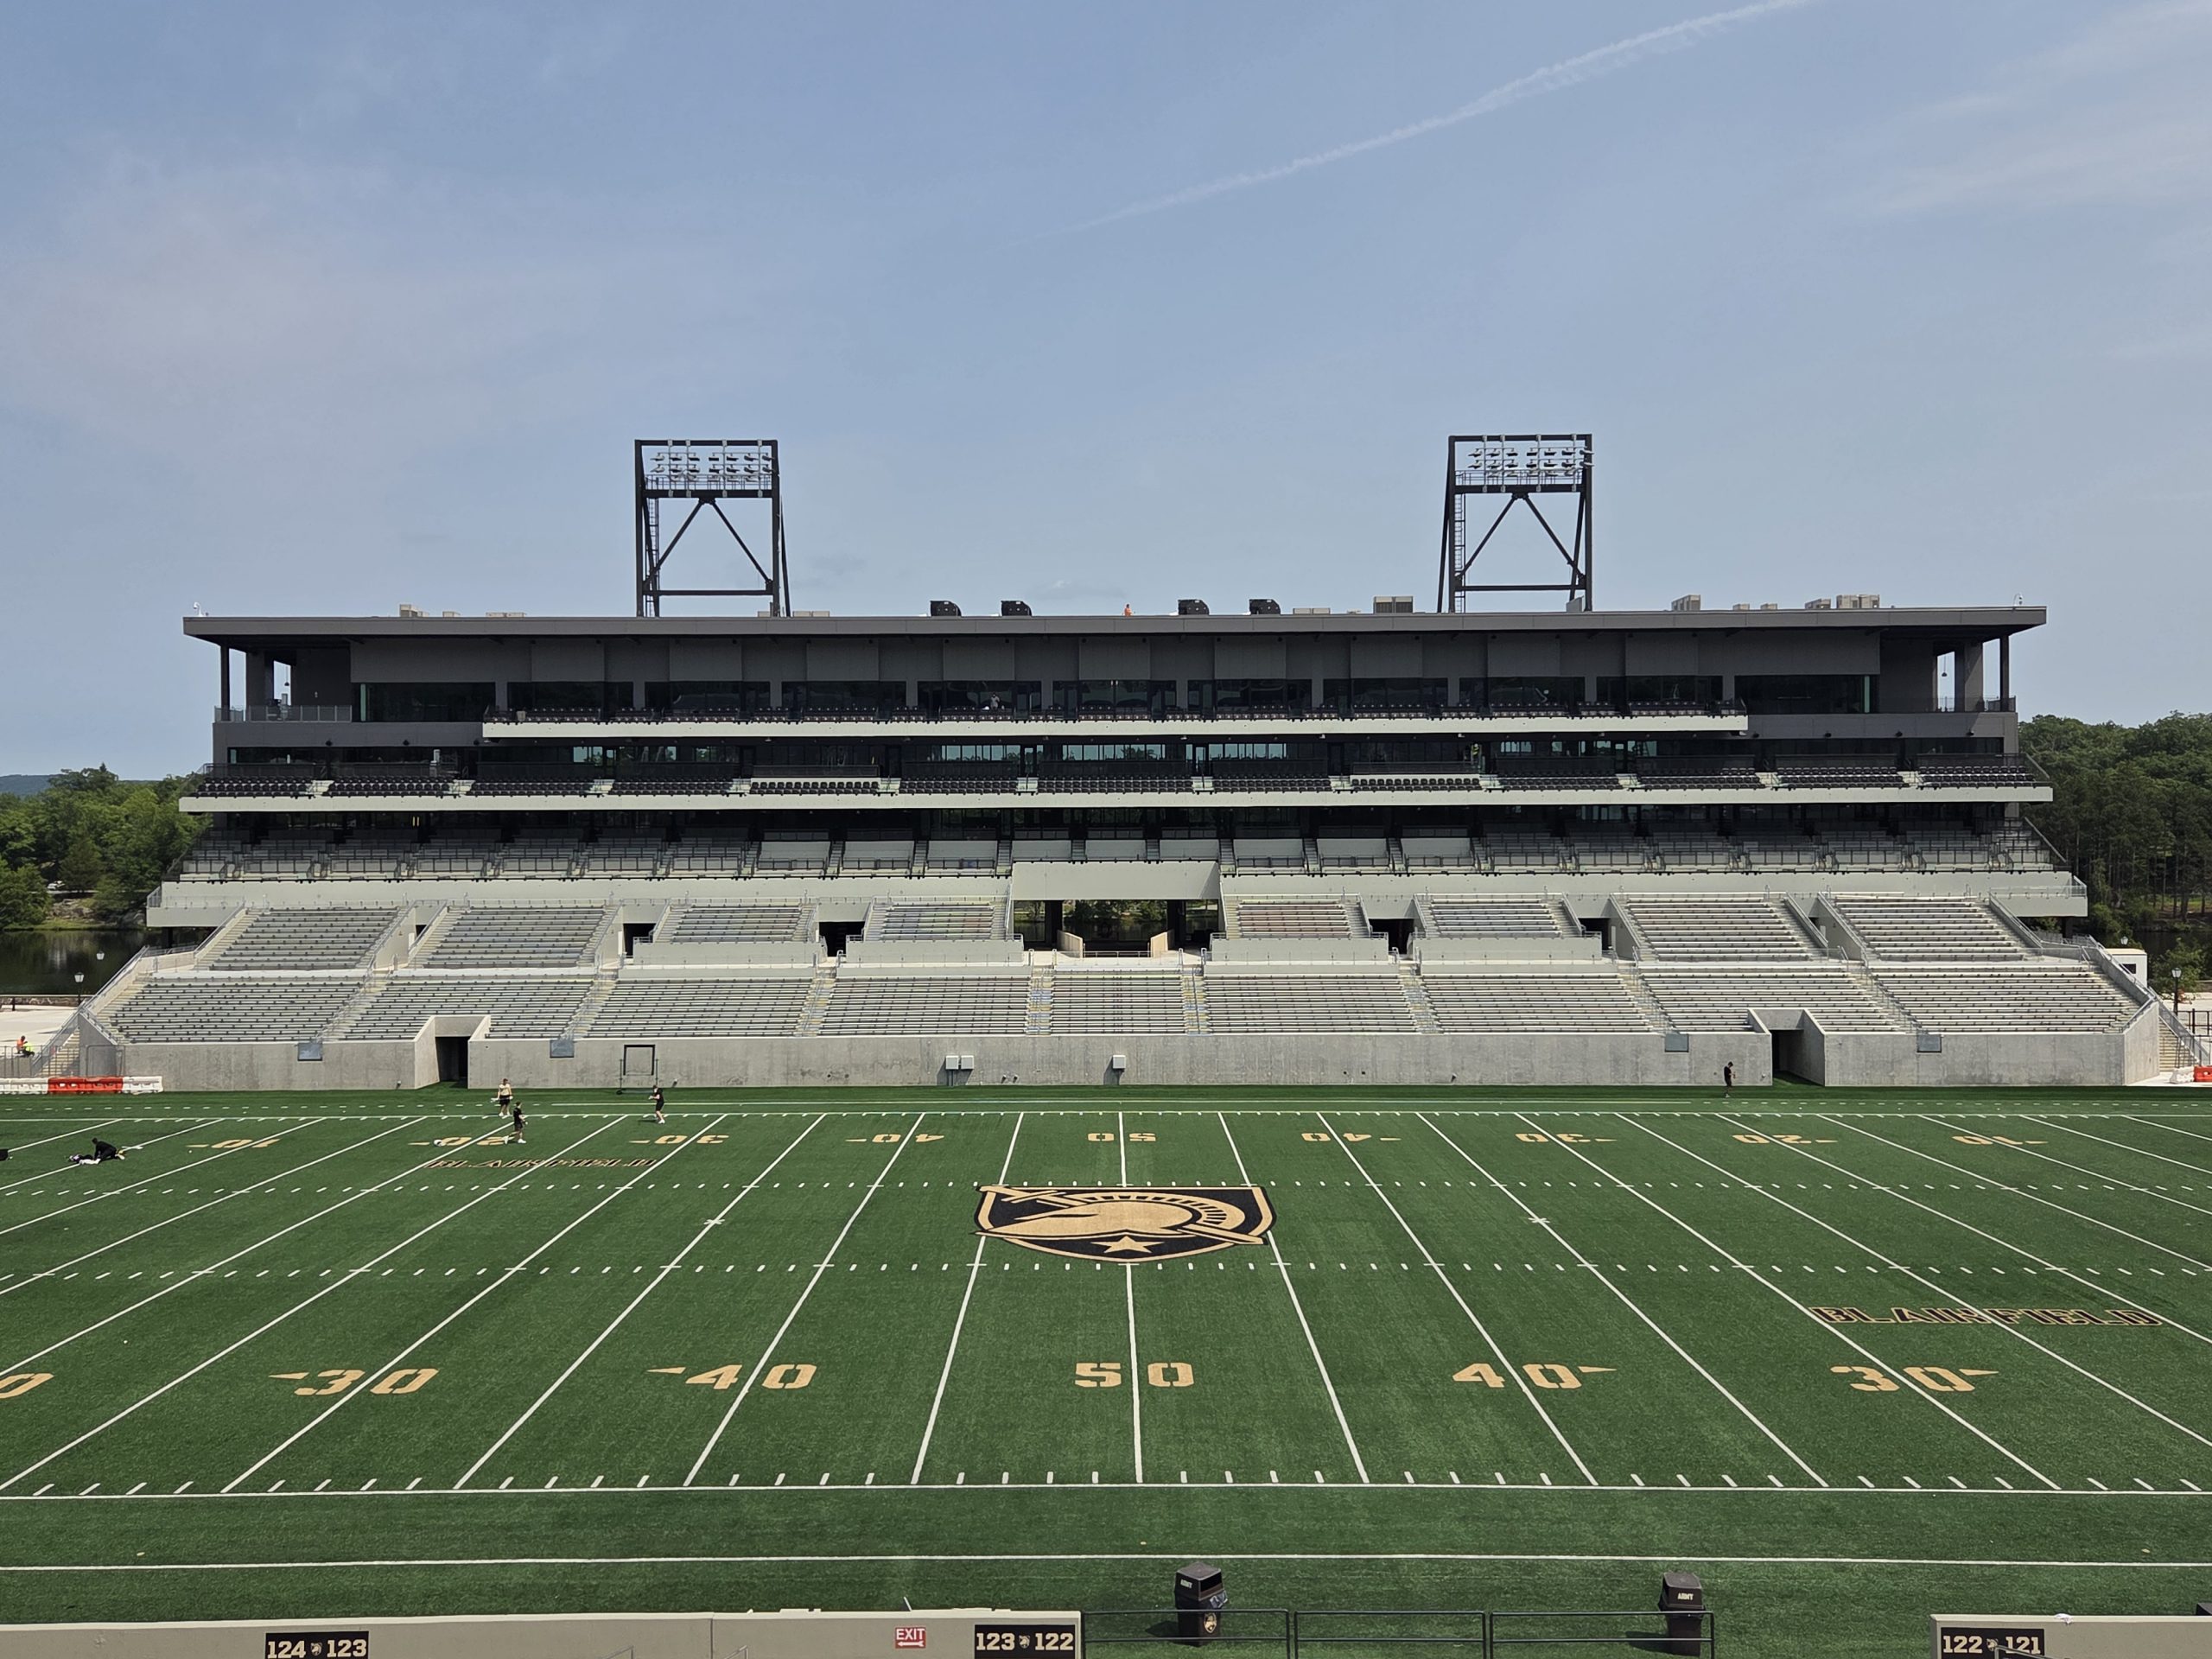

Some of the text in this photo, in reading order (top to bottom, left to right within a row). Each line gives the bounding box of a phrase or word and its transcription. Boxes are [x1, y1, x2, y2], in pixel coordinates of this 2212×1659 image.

[873, 1133, 944, 1143] 40
[1087, 1133, 1157, 1142] 50
[1301, 1133, 1372, 1142] 40
[1809, 1306, 2164, 1325] BLAIK FIELD
[294, 1369, 439, 1395] 30
[687, 1364, 817, 1390] 40
[1075, 1363, 1195, 1388] 50
[1452, 1363, 1582, 1389] 40
[1829, 1366, 1975, 1391] 30
[896, 1628, 925, 1640] EXIT
[976, 1632, 1074, 1650] 123 122
[267, 1639, 367, 1659] 124 123
[1942, 1636, 2041, 1655] 122 121
